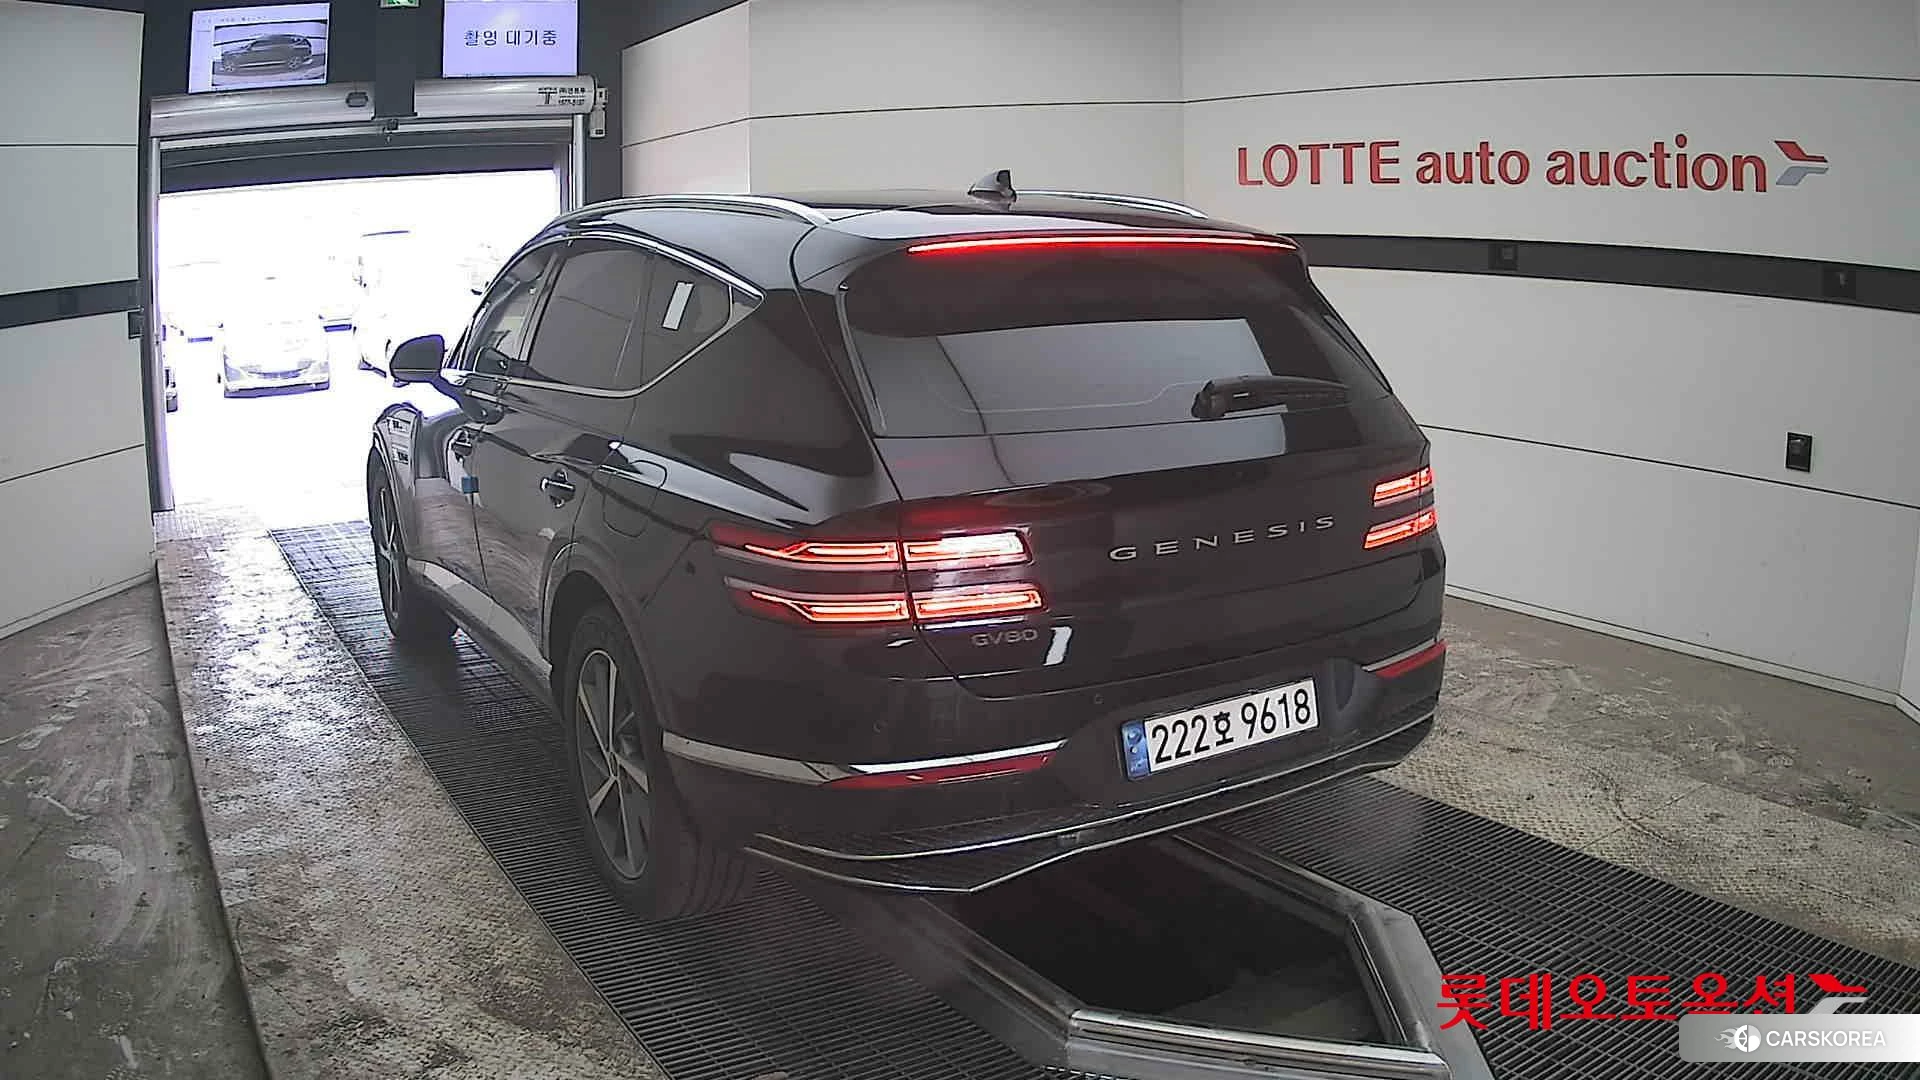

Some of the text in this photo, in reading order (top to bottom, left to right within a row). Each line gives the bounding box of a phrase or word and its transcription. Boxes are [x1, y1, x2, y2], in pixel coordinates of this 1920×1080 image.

[464, 29, 558, 47] 촬영 대기중
[1237, 133, 1768, 193] LOTTE auto auction
[1109, 516, 1334, 561] GENESIS
[971, 628, 1039, 647] GV80
[1151, 688, 1311, 764] 222호 9618
